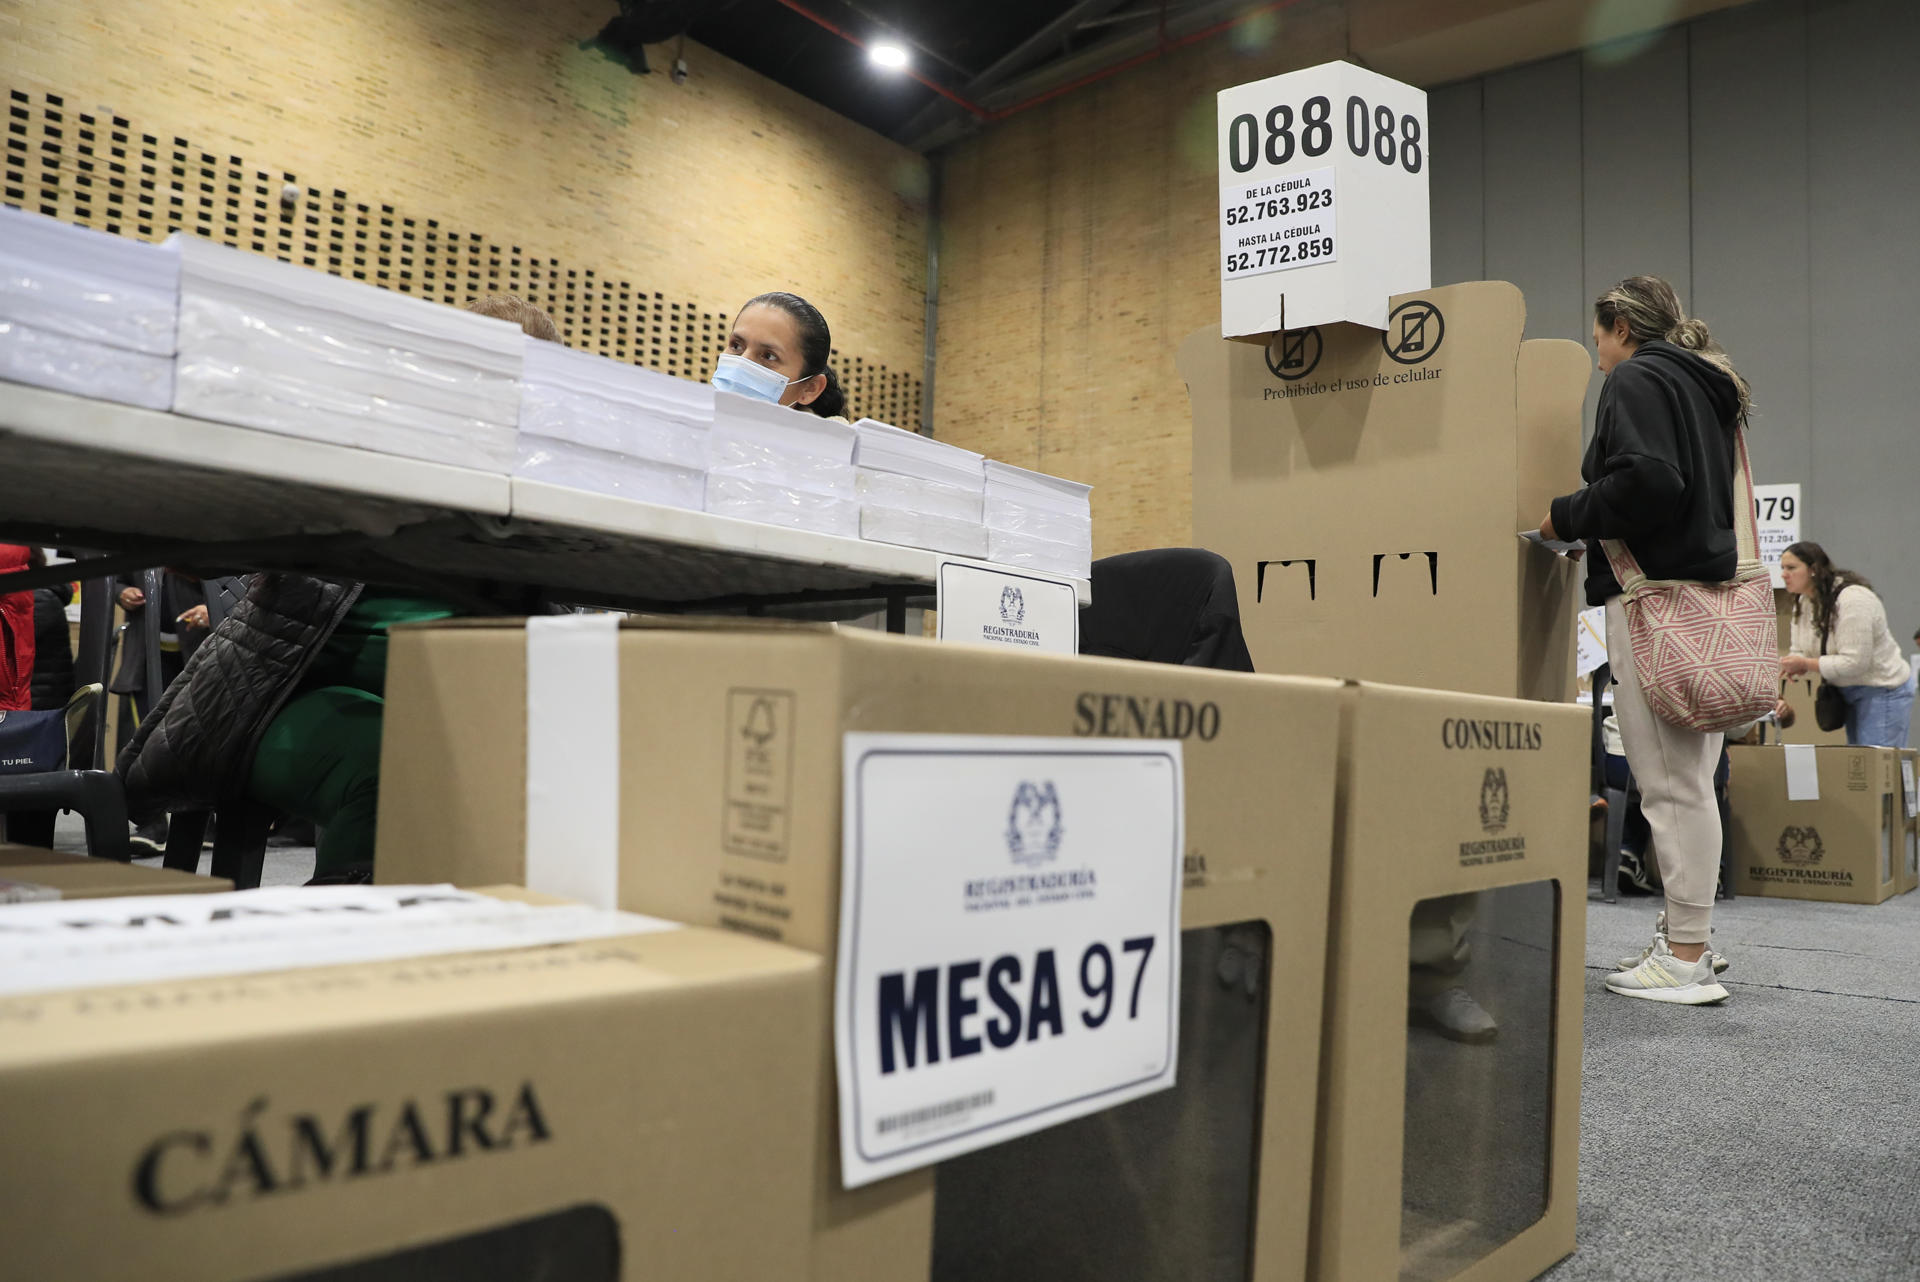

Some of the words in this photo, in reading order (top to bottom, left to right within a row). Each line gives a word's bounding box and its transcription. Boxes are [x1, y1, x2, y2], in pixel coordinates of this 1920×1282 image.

[1229, 95, 1333, 174] 088
[1346, 95, 1422, 174] 088
[1246, 189, 1258, 200] DE
[1261, 186, 1272, 197] LA
[1274, 177, 1311, 194] CÉDULA
[1226, 188, 1333, 226] 52.763.923
[1238, 234, 1267, 248] HASTA
[1270, 231, 1281, 242] LA
[1284, 224, 1321, 240] CÉDULA
[1227, 237, 1334, 273] 52.772.859
[1263, 382, 1327, 401] Prohibido
[1330, 379, 1342, 392] el
[1346, 379, 1369, 390] uso
[1373, 373, 1390, 387] de
[1393, 366, 1442, 385] celular
[1073, 691, 1221, 742] SENADO
[1441, 717, 1542, 750] CONSULTAS
[15, 757, 34, 765] PIEL
[1749, 866, 1853, 881] REGISTRADURÍA
[878, 946, 1064, 1076] MESA
[1079, 935, 1155, 1030] 97
[128, 1077, 552, 1219] CÁMARA
